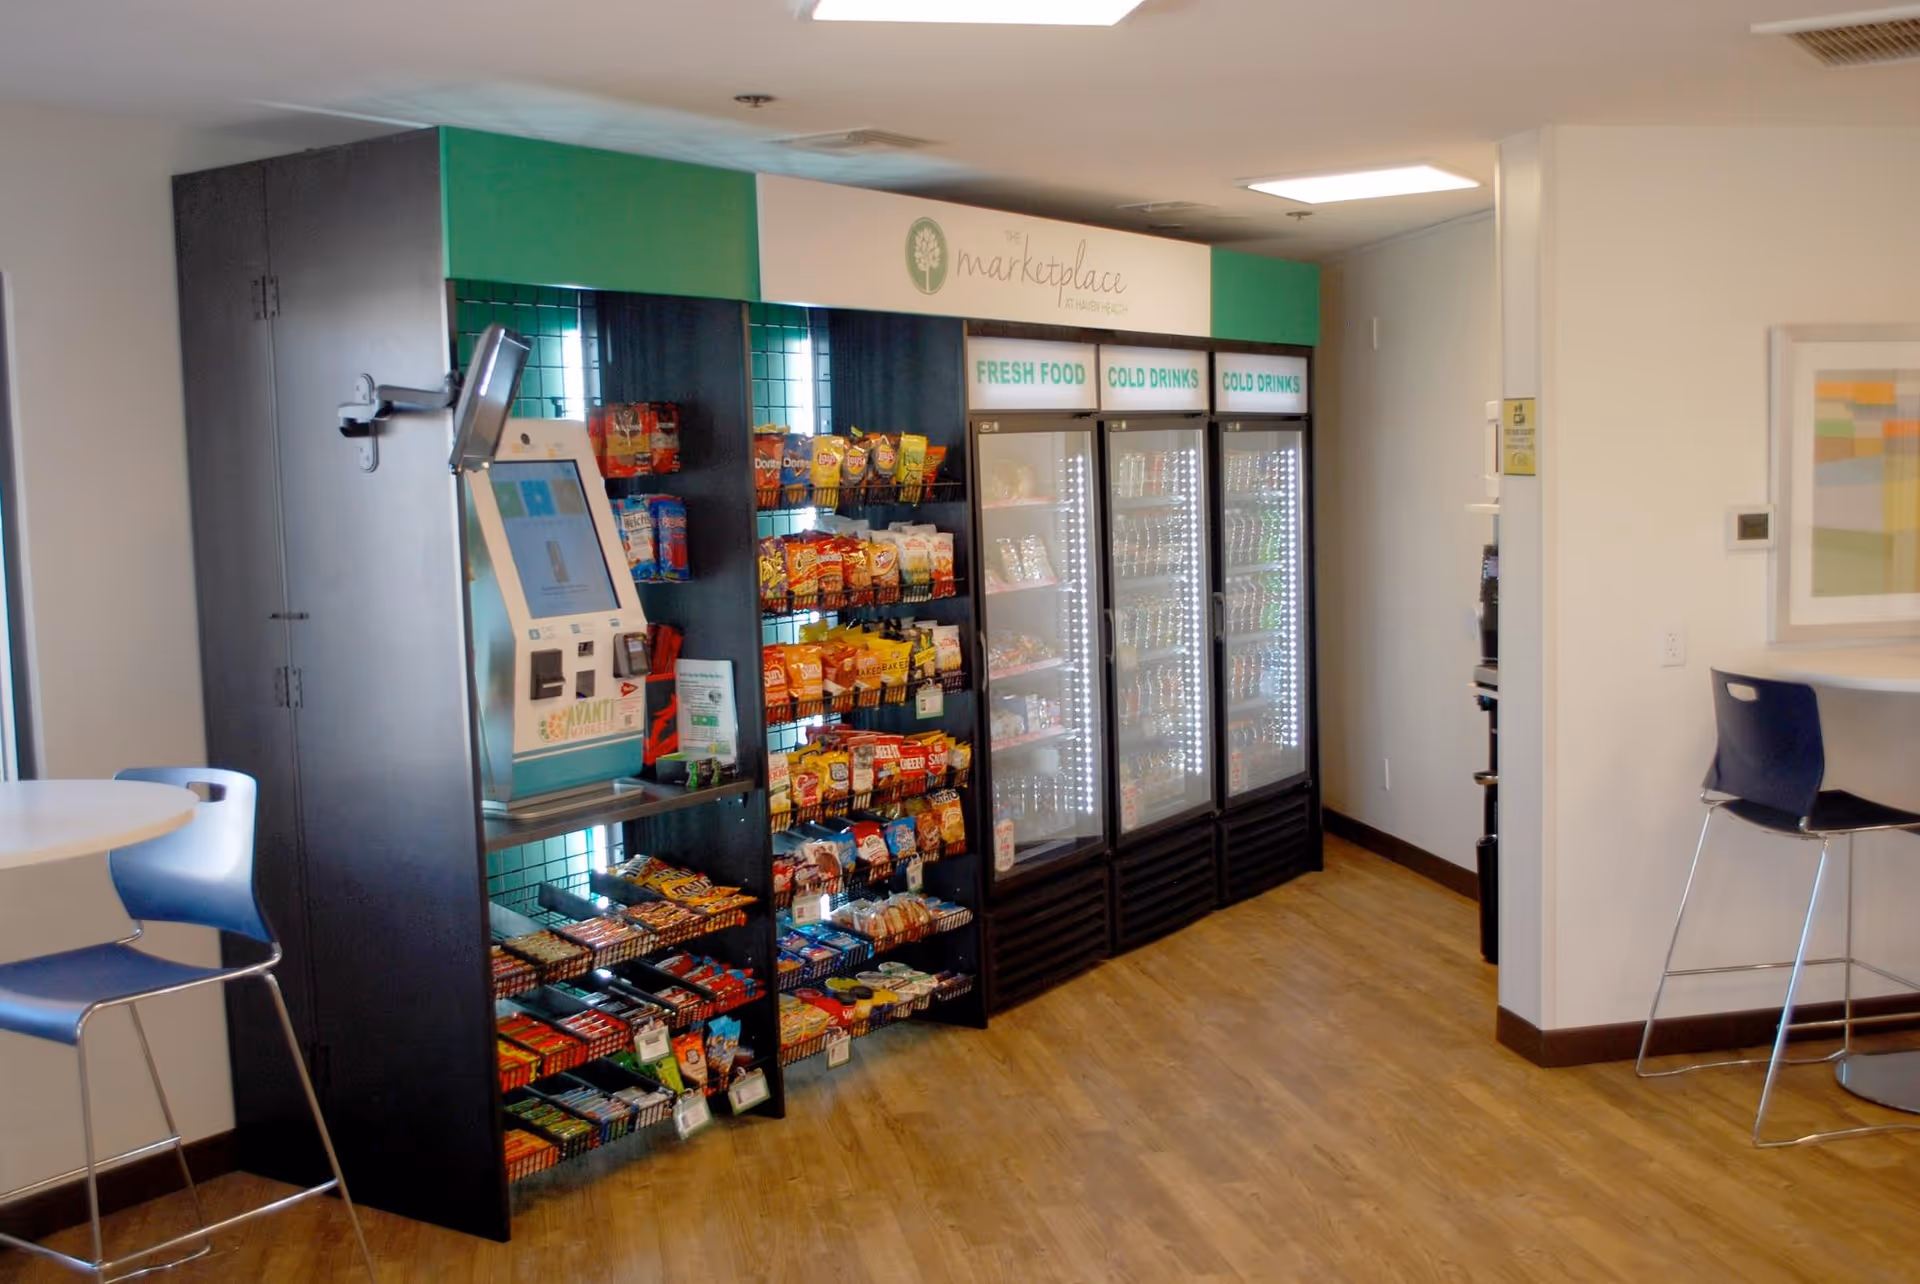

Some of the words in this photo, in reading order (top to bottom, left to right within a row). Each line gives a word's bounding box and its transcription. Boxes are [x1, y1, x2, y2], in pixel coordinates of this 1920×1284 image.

[1005, 230, 1021, 243] THE
[957, 232, 1128, 308] marketplace
[976, 360, 1035, 385] FRESH
[1040, 362, 1086, 386] FOOD
[1107, 366, 1146, 388] COLD
[1149, 368, 1199, 390] DRINKS
[1222, 371, 1254, 392] COLD
[1257, 373, 1300, 394] DRINKS
[882, 659, 909, 673] BAKED
[568, 699, 614, 726] AVANTI
